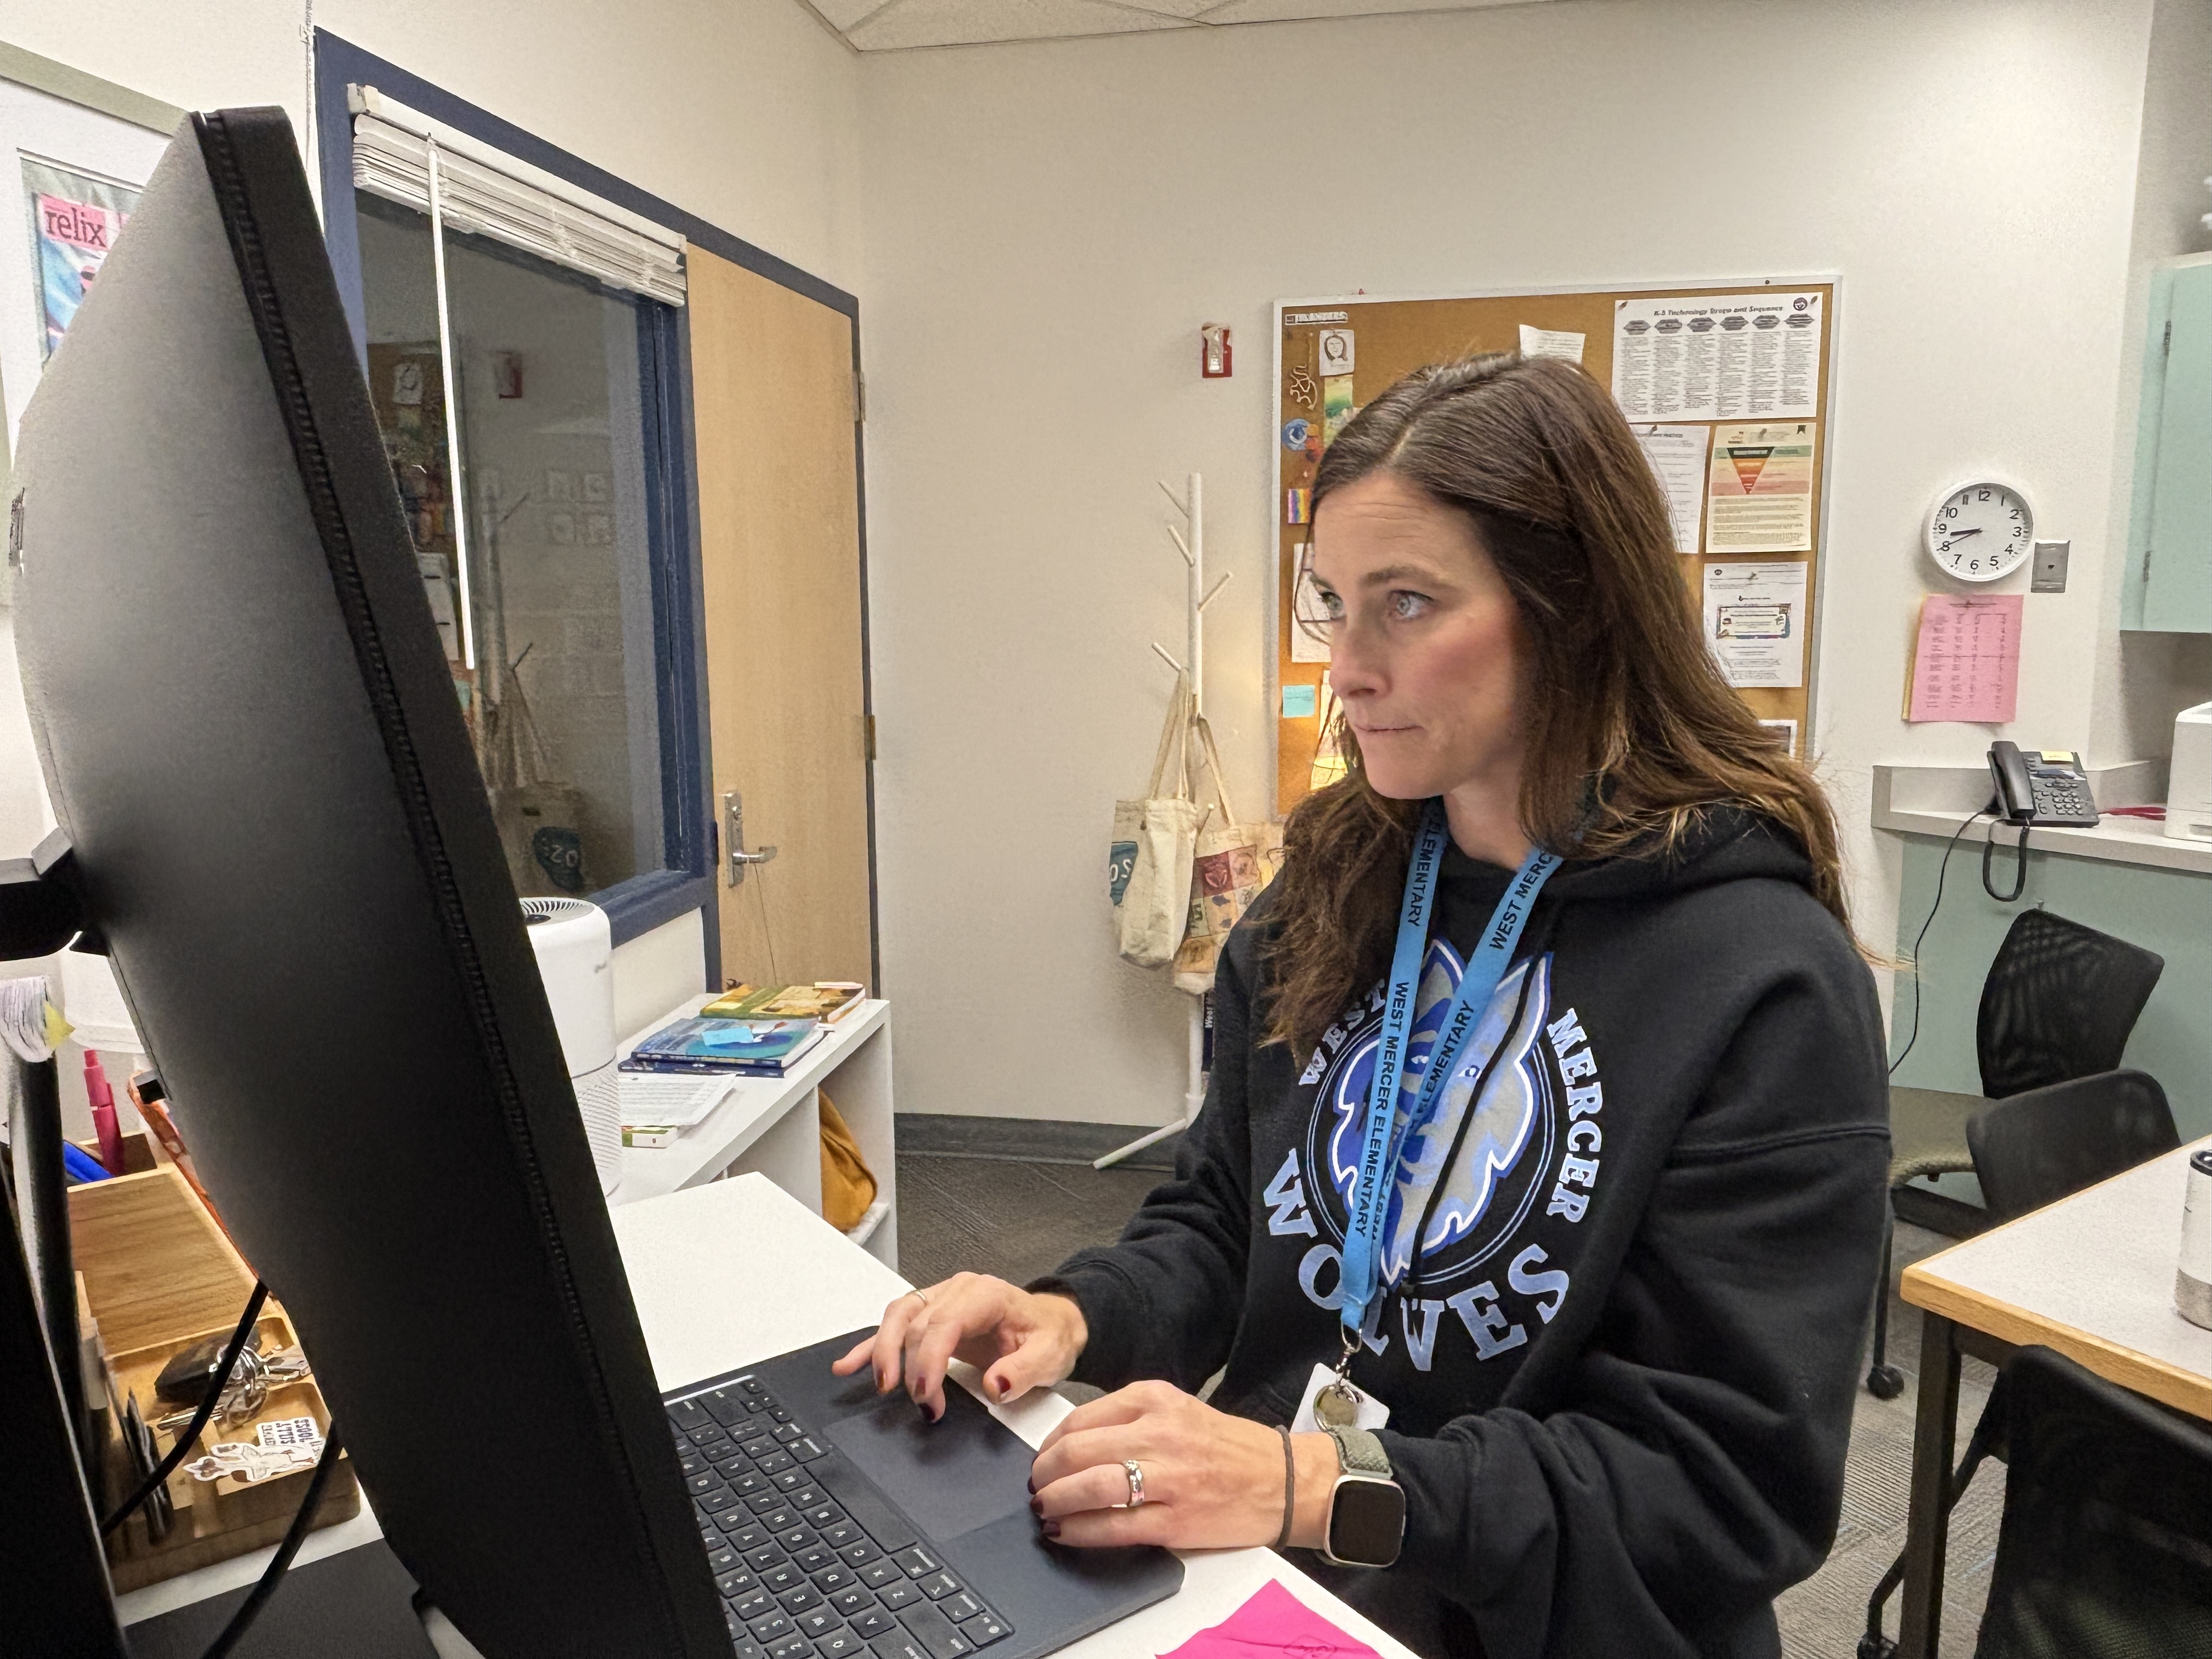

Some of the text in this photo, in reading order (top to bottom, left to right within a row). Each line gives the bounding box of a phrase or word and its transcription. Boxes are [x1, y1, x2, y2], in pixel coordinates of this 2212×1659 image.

[44, 207, 108, 249] relix
[1978, 490, 1991, 501] 12
[1945, 506, 1958, 518] 10
[2009, 509, 2019, 520] 2
[1938, 523, 1947, 534] 9
[2012, 526, 2022, 537] 3
[1942, 541, 1950, 551] 8
[2004, 543, 2013, 555] 4
[1954, 554, 1962, 565] 7
[1970, 560, 1979, 569] 6
[1989, 555, 1999, 567] 5
[1408, 819, 1442, 927] LEMENTARY
[1489, 849, 1554, 951] WEST MERC
[1298, 979, 1386, 1086] WEST
[1355, 981, 1410, 1238] WEST MERCER ELEMENTARY
[1546, 1007, 1604, 1223] MERCER
